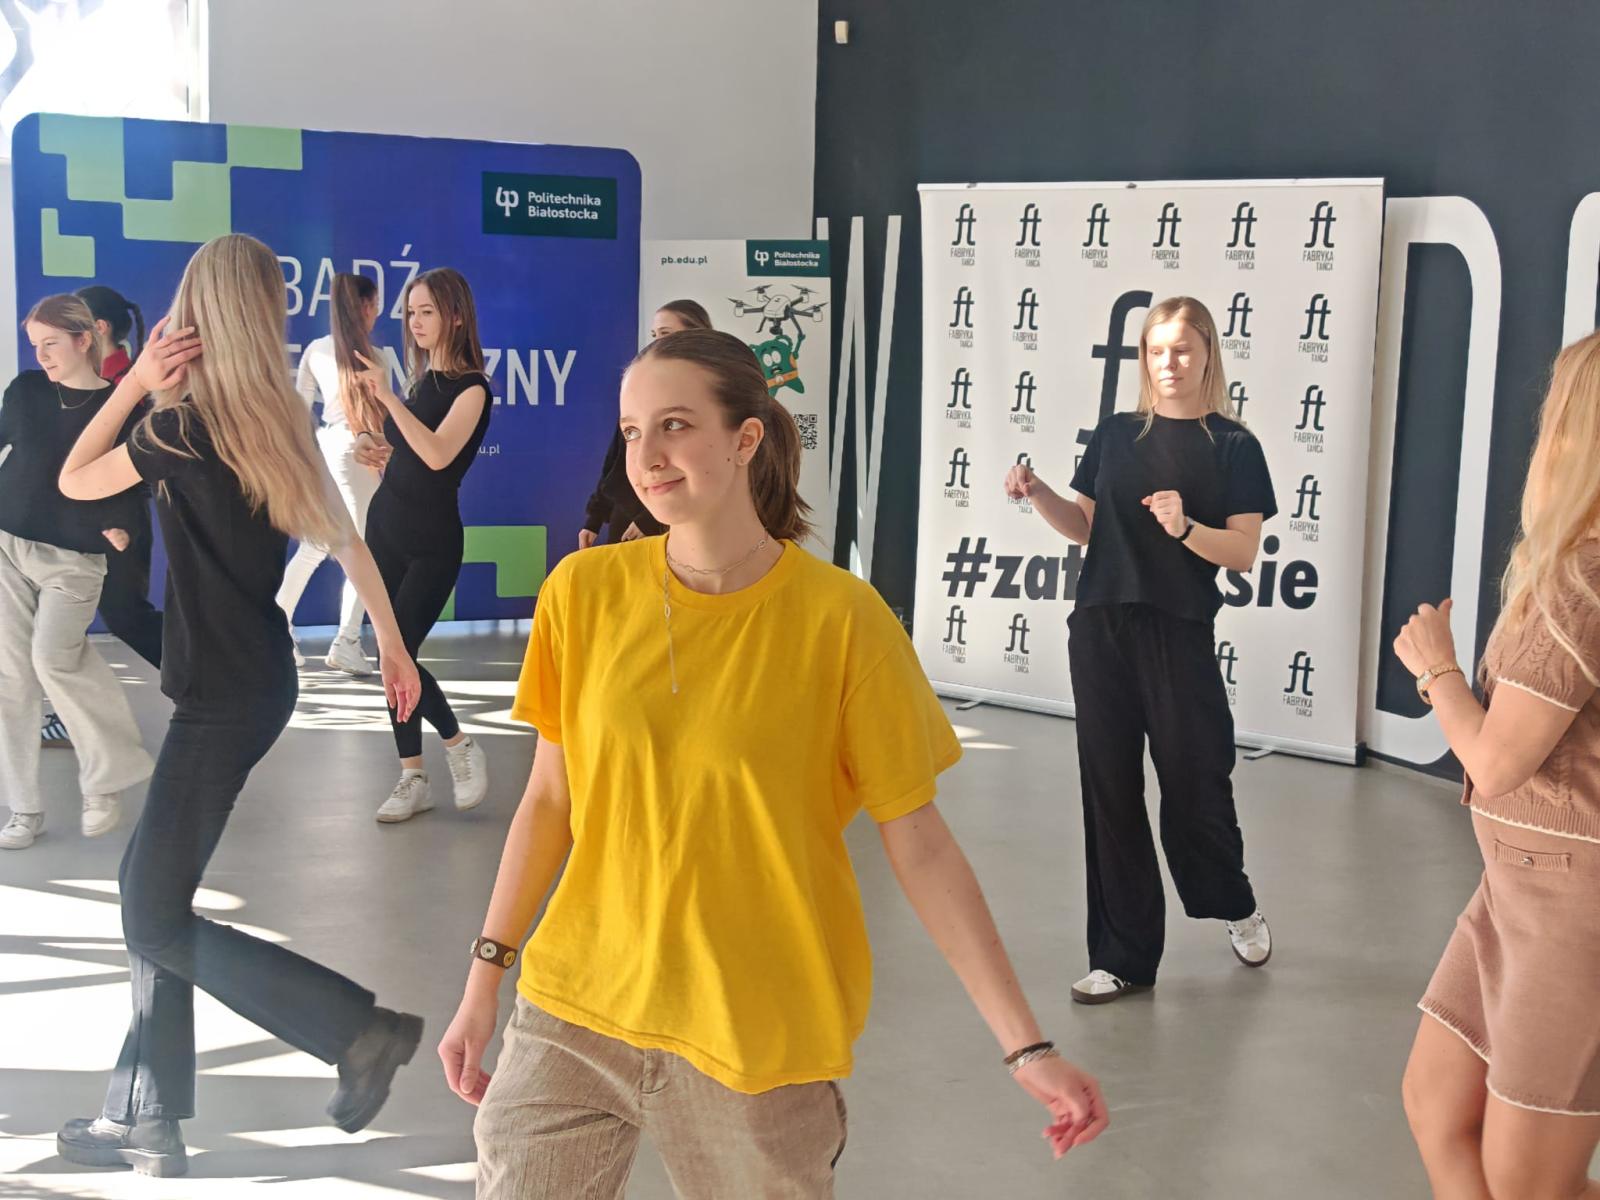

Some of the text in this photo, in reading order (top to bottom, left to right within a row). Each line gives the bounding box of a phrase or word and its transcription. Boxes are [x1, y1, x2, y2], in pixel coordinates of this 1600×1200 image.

[528, 191, 601, 206] Politechnika
[528, 205, 598, 220] Białostocka
[661, 256, 708, 265] pb.edu.pl
[774, 250, 820, 259] Politechnika
